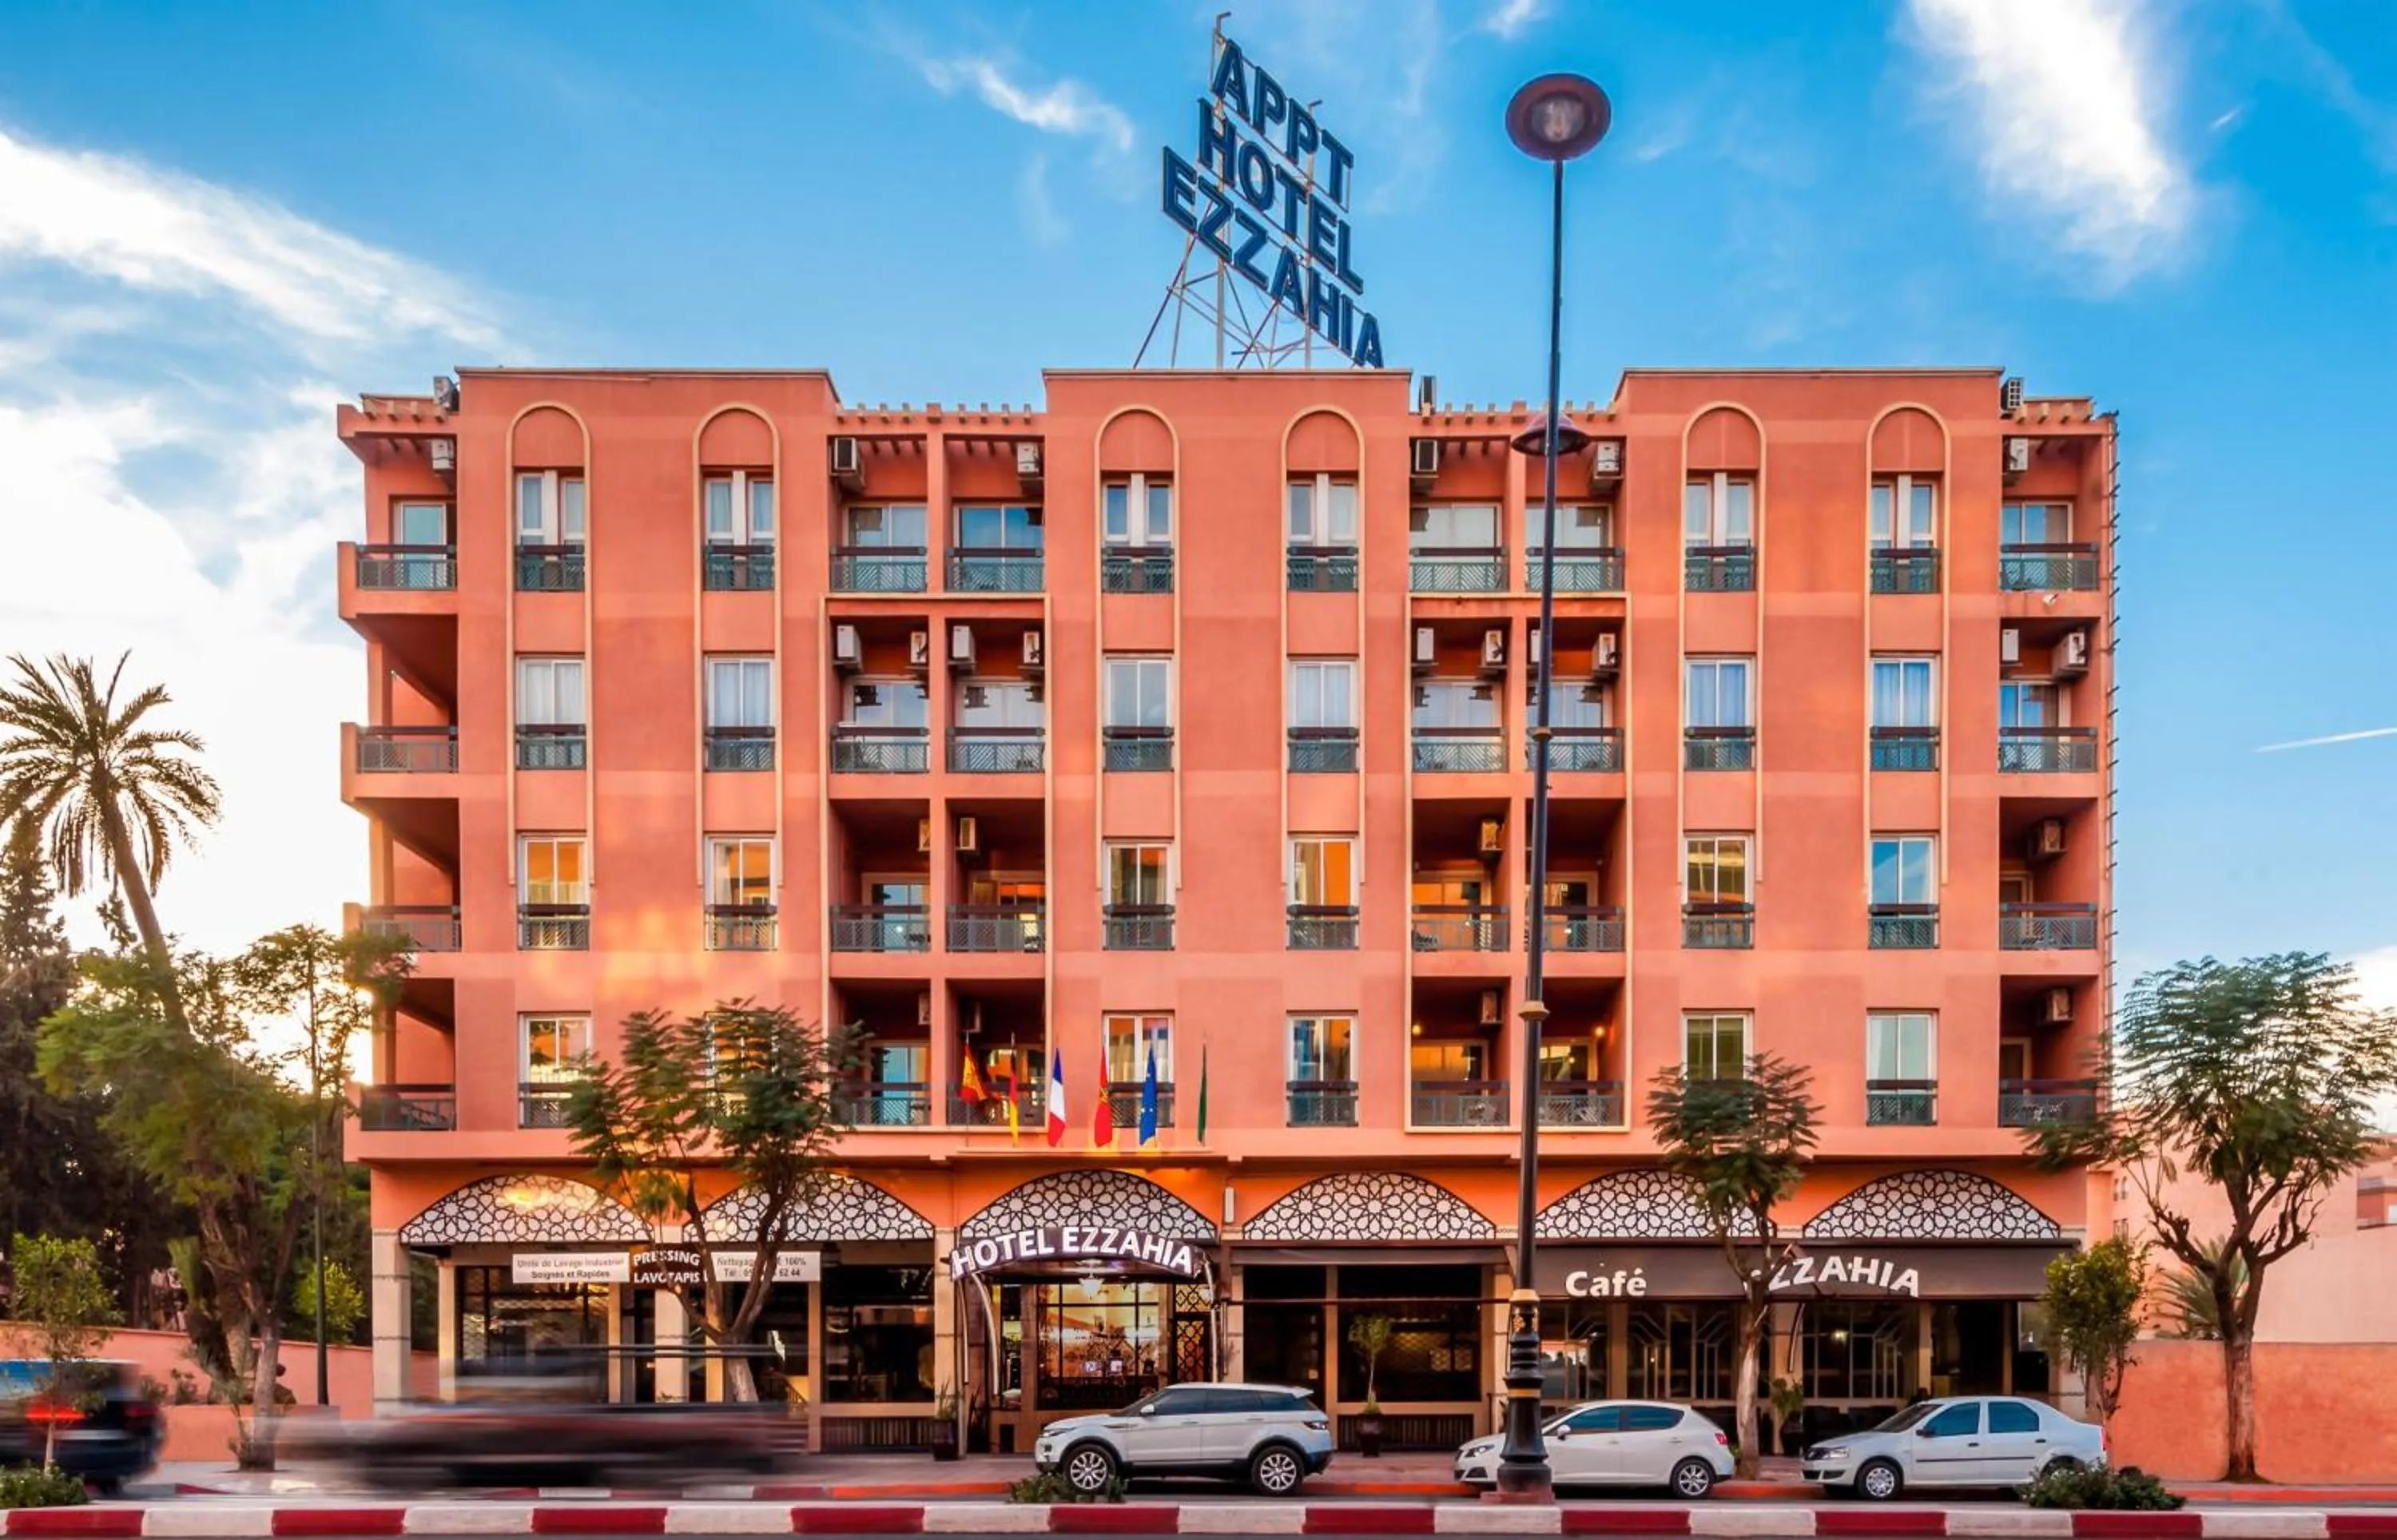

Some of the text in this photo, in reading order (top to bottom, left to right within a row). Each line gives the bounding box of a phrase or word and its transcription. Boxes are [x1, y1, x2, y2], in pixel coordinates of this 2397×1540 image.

[1211, 39, 1354, 205] APPT
[1197, 97, 1364, 295] HOTEL
[1163, 145, 1384, 368] EZZAHIA
[633, 1249, 701, 1266] PRESSING
[952, 1226, 1192, 1277] HOTEL EZZAHIA
[1565, 1255, 1919, 1298] Café ZZAHIA
